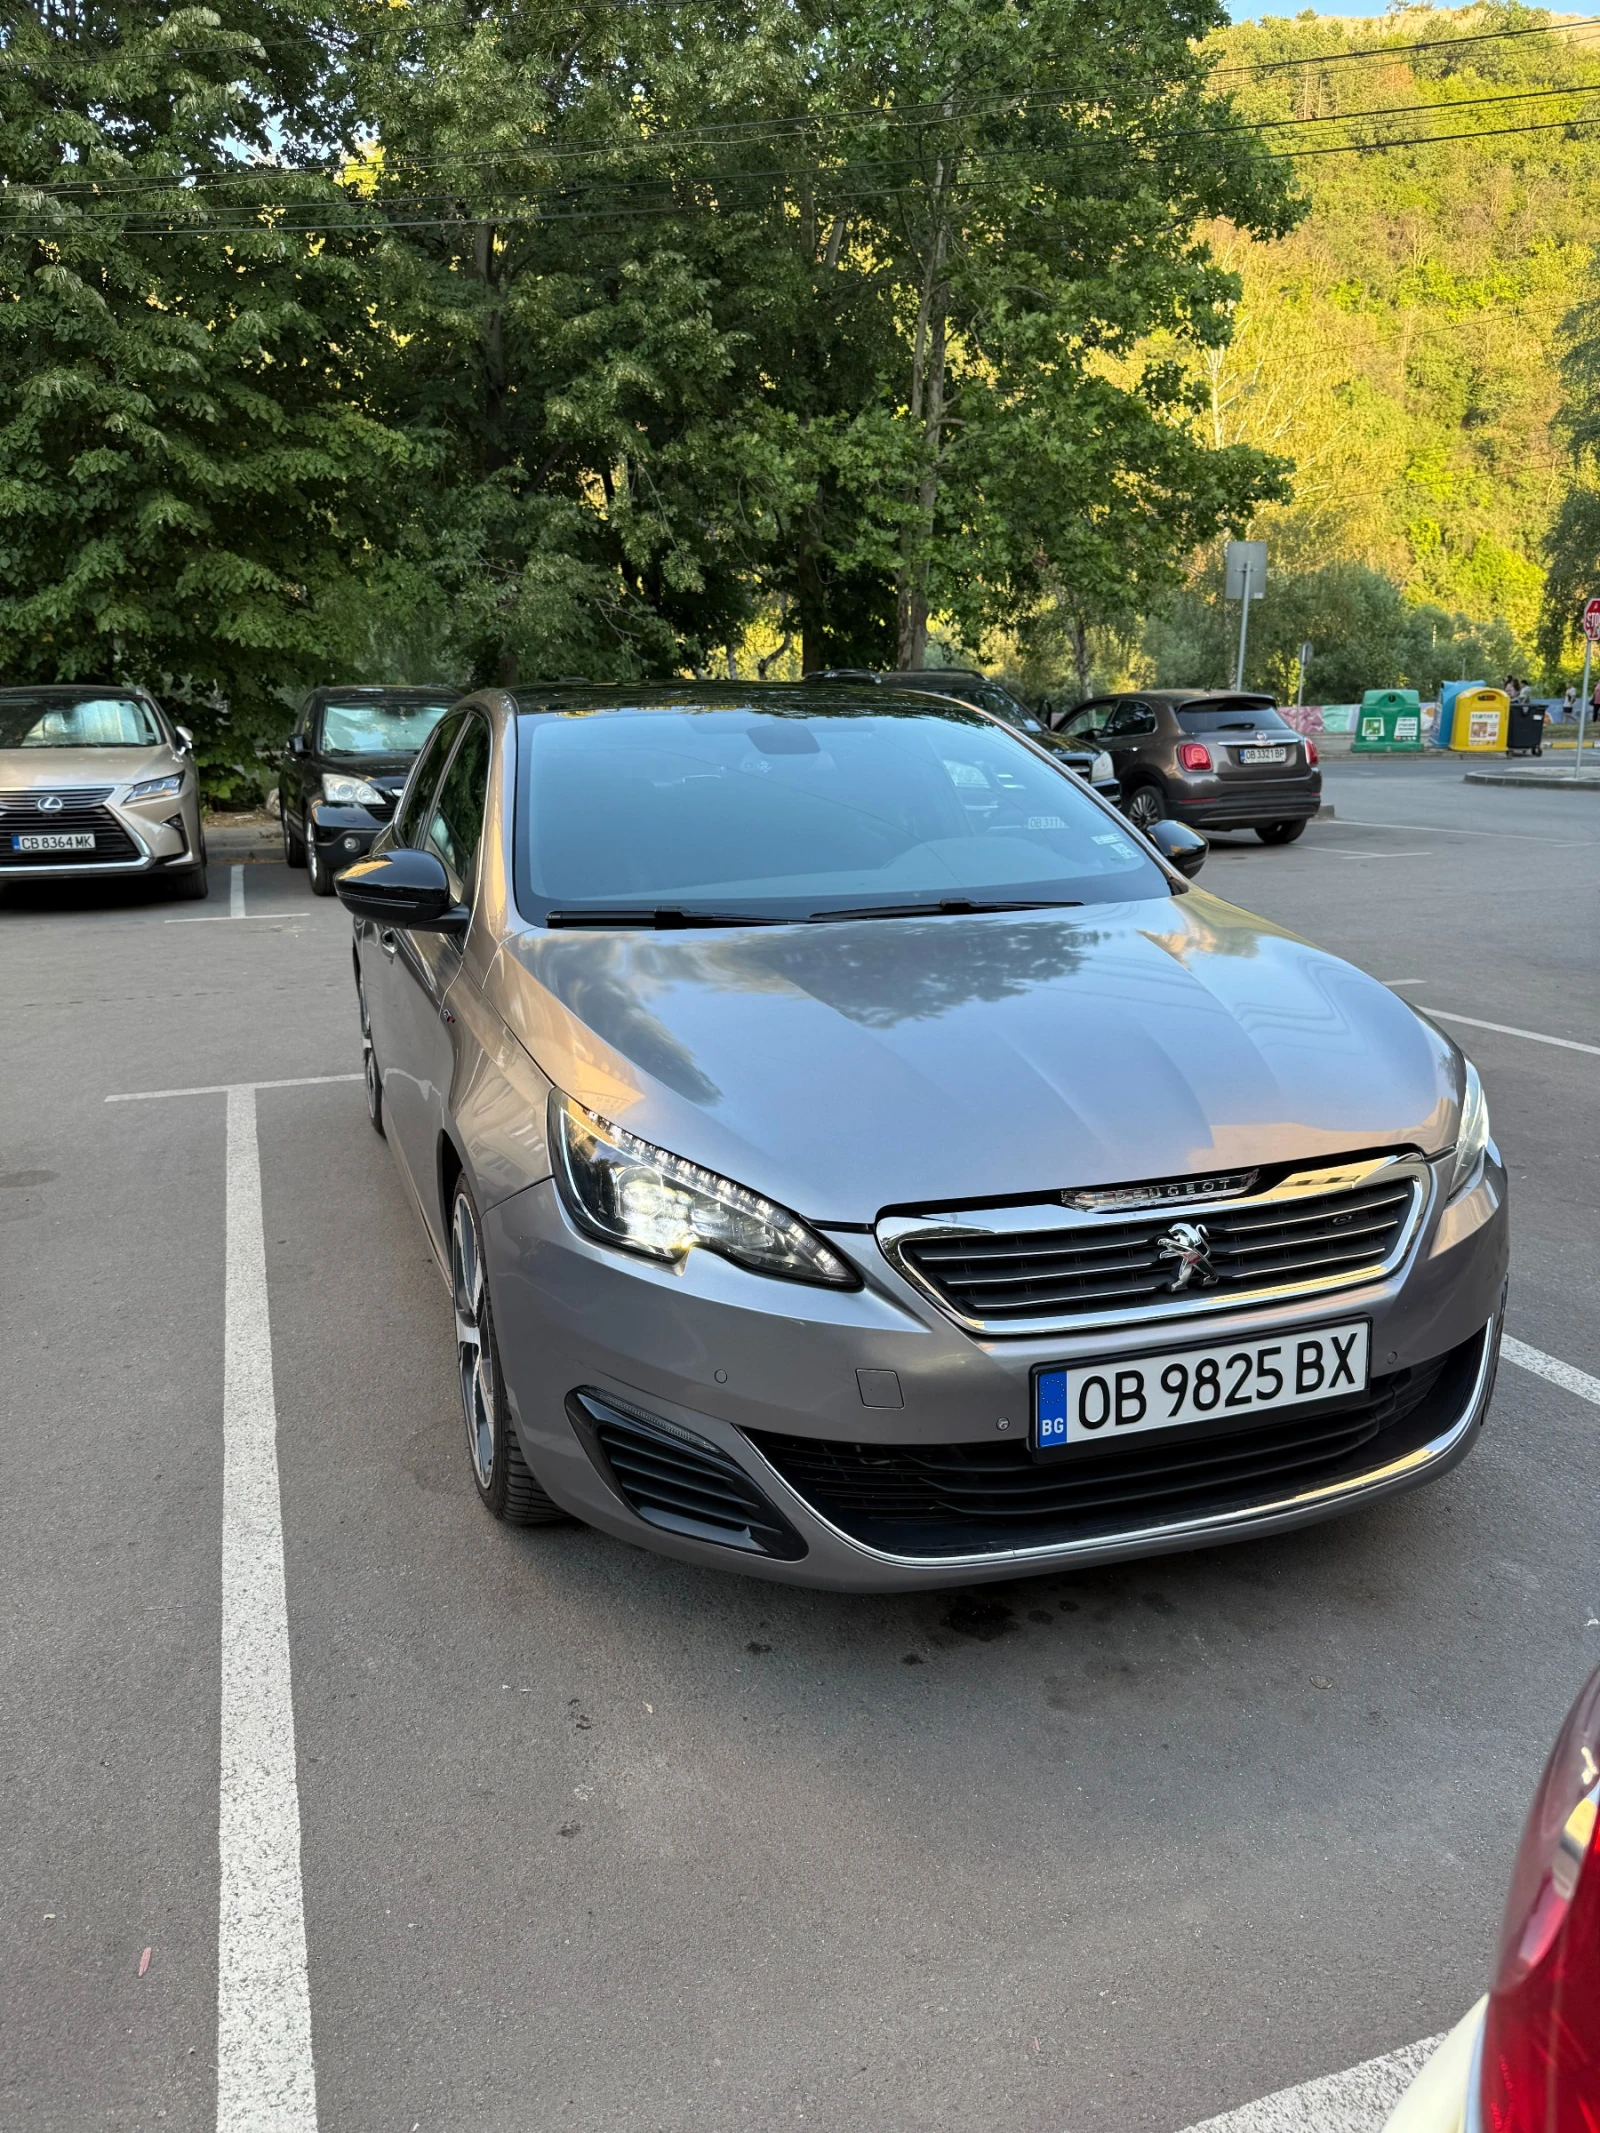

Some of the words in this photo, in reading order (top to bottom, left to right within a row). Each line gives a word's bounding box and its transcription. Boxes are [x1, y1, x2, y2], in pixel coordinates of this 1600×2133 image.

[1257, 750, 1274, 759] 3321
[21, 837, 40, 850] CB
[41, 836, 73, 849] 8364
[75, 835, 93, 848] MK
[1115, 1180, 1230, 1201] PEUGEOT
[1041, 1417, 1064, 1437] BG
[1078, 1370, 1147, 1431] OB
[1160, 1346, 1284, 1418] 9825
[1295, 1332, 1358, 1395] BX
